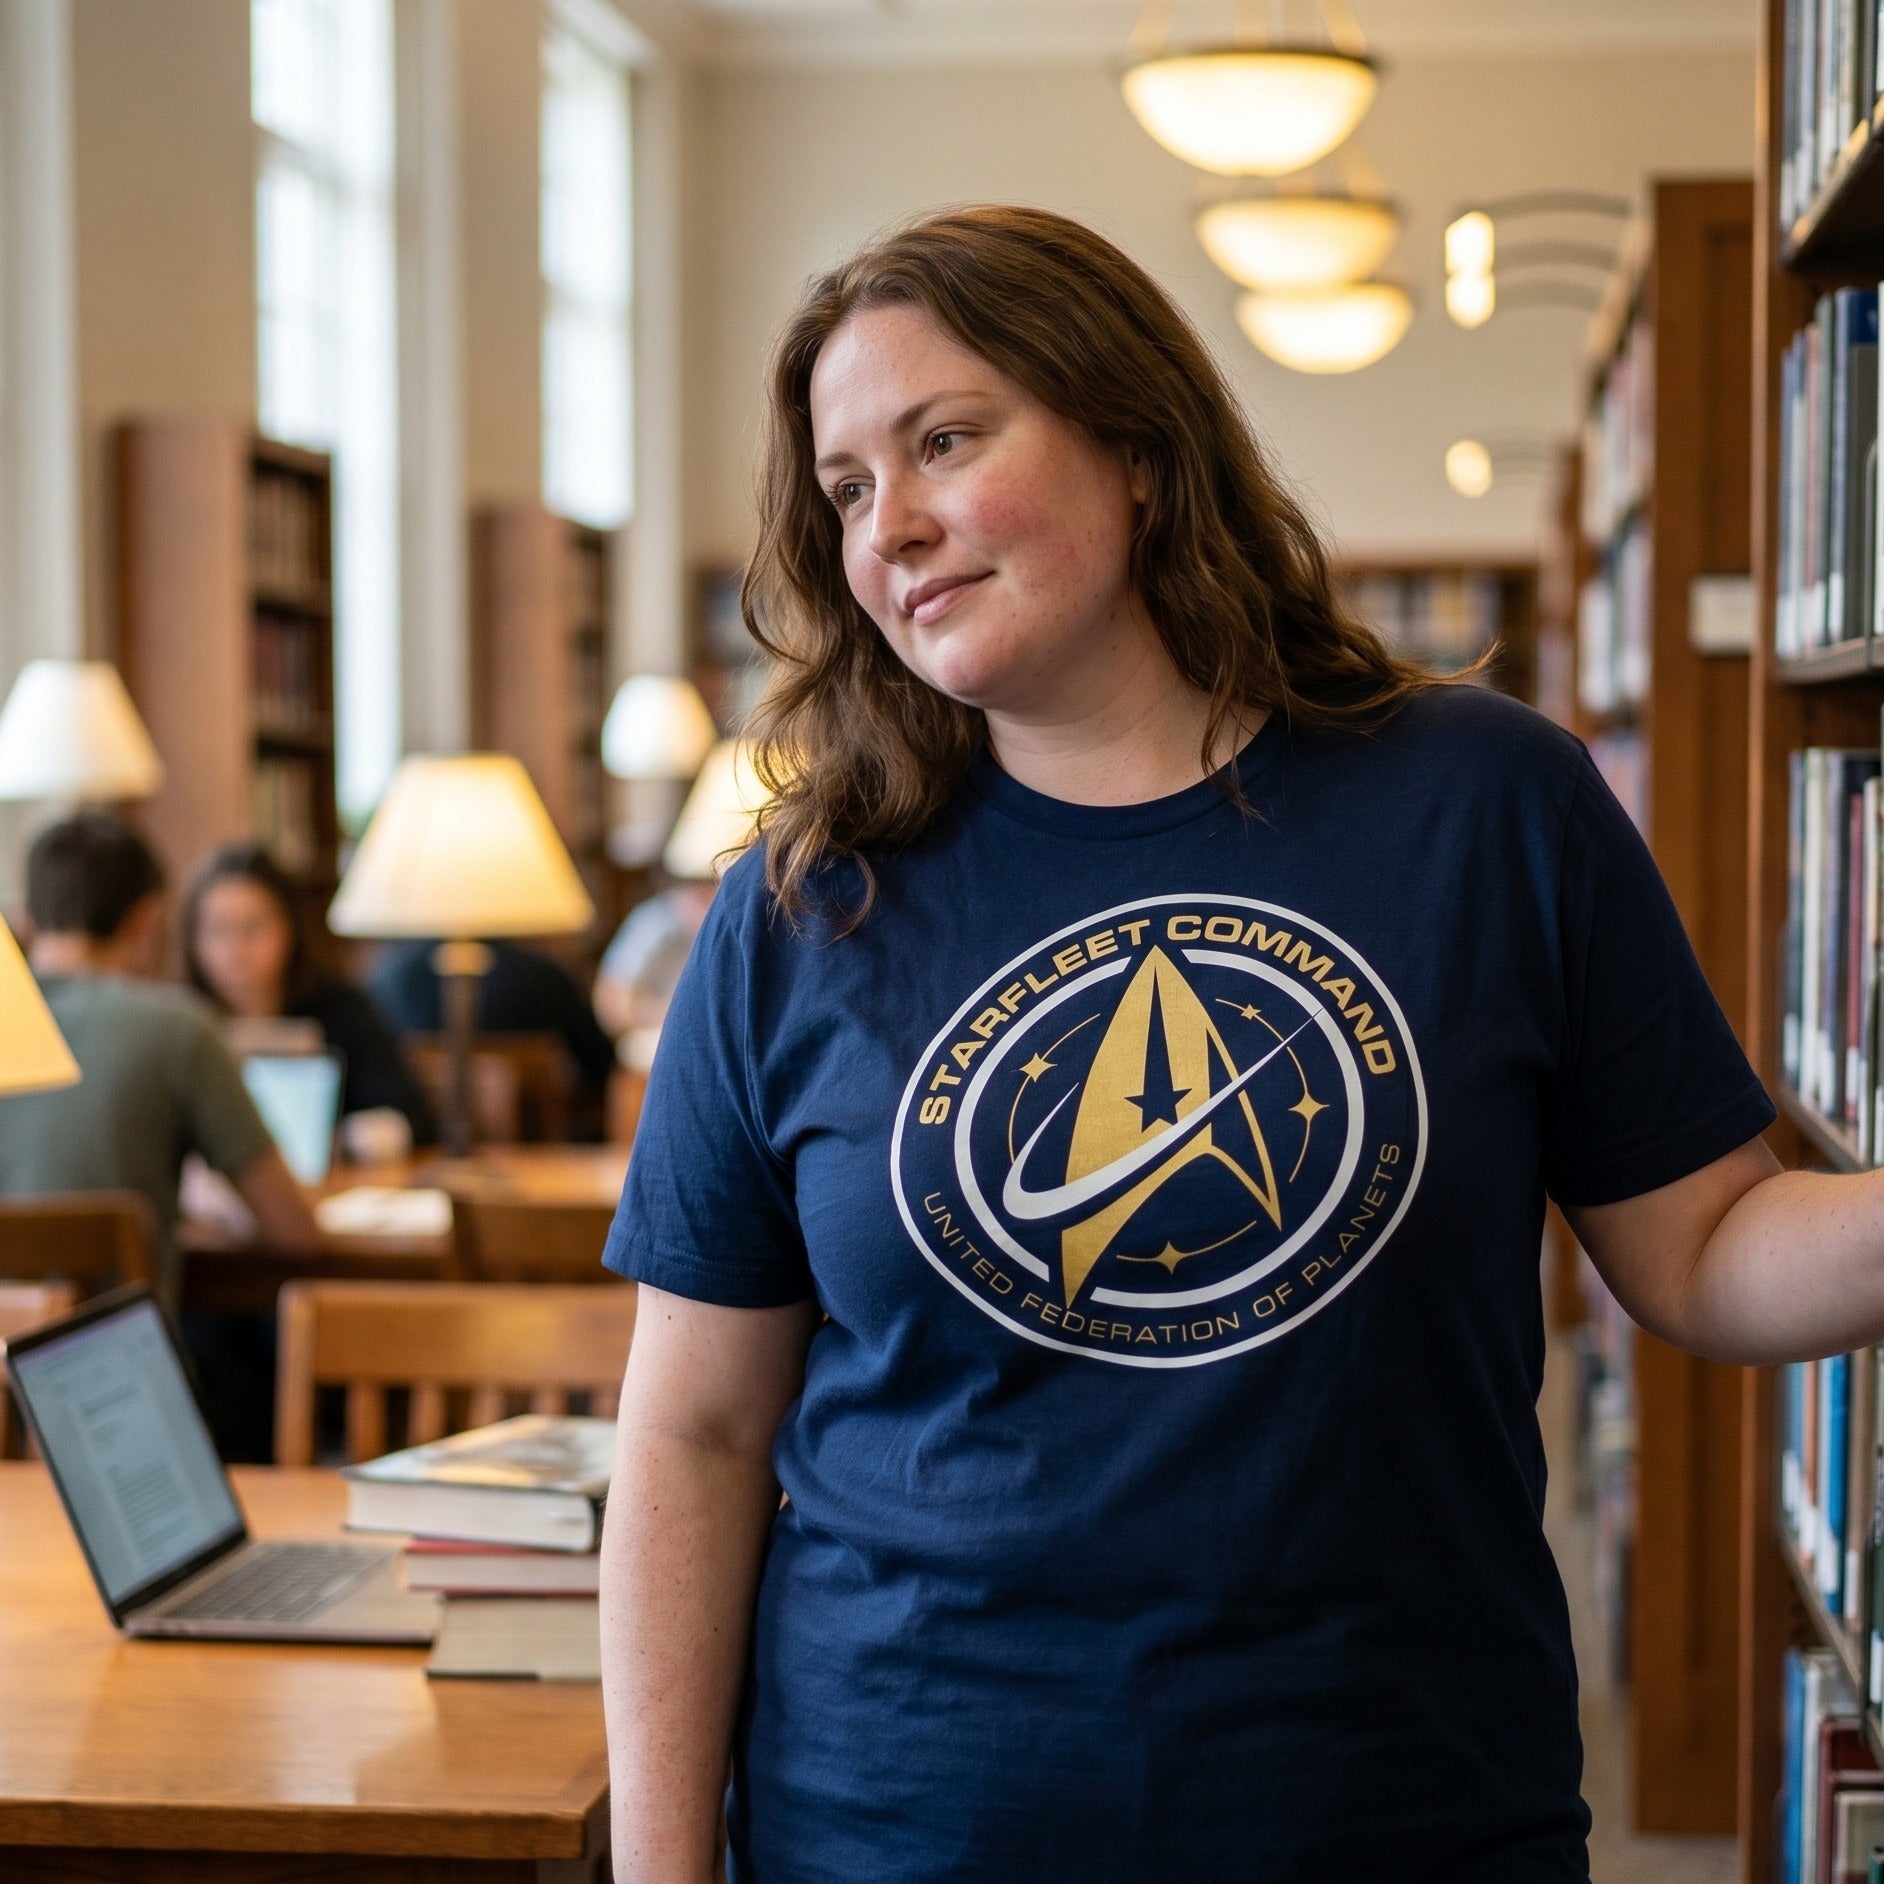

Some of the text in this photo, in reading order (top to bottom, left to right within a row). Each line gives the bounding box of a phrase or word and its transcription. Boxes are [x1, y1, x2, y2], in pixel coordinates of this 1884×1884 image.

[919, 915, 1397, 1125] STARFLEET COMMAND
[924, 1143, 1400, 1344] UNITED FEDERATION OF PLANETS
